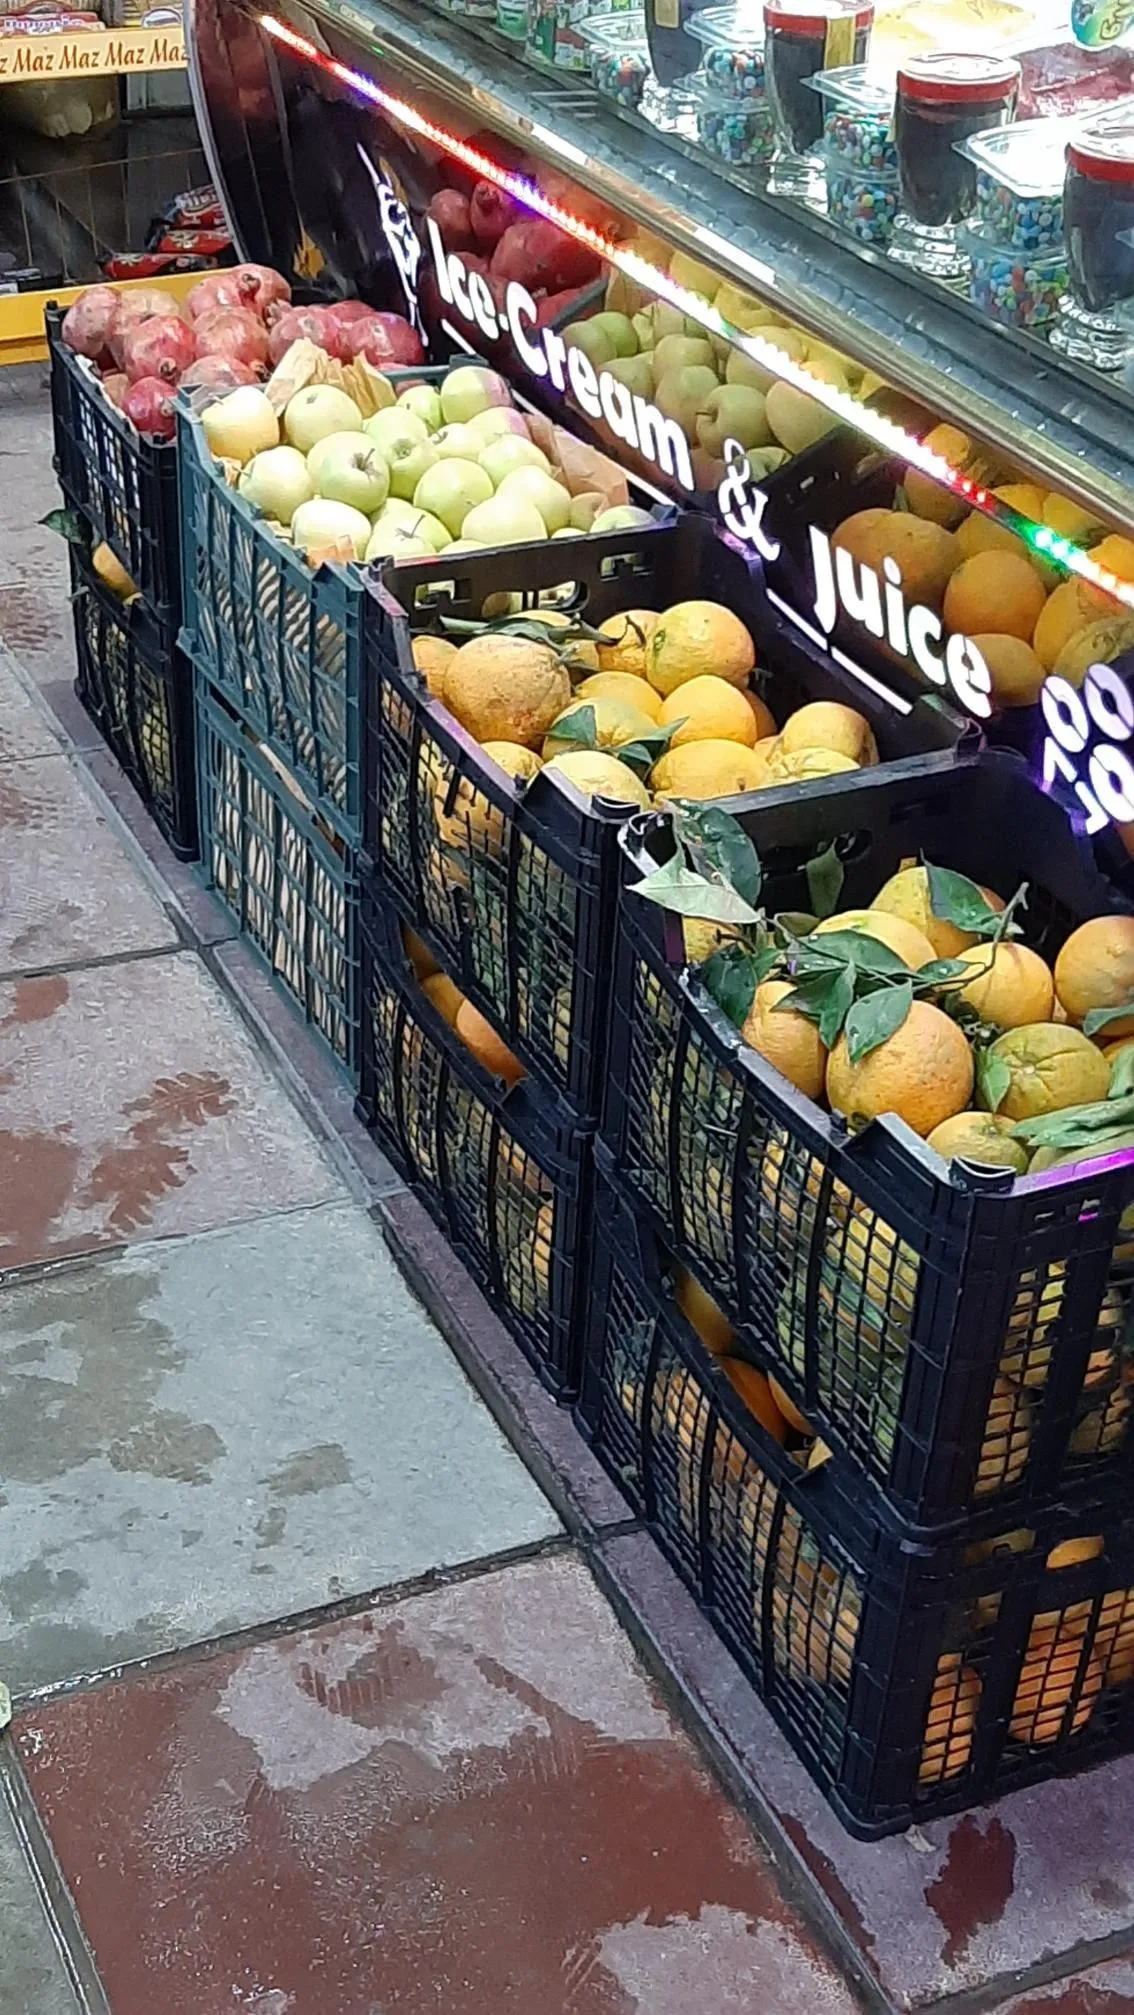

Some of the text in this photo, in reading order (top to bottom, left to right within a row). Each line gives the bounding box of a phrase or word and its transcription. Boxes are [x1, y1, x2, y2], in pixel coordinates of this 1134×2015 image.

[13, 47, 54, 73] Maz
[59, 44, 100, 70] Maz
[104, 41, 145, 67] Maz
[717, 437, 781, 562] &
[808, 525, 993, 718] Juice
